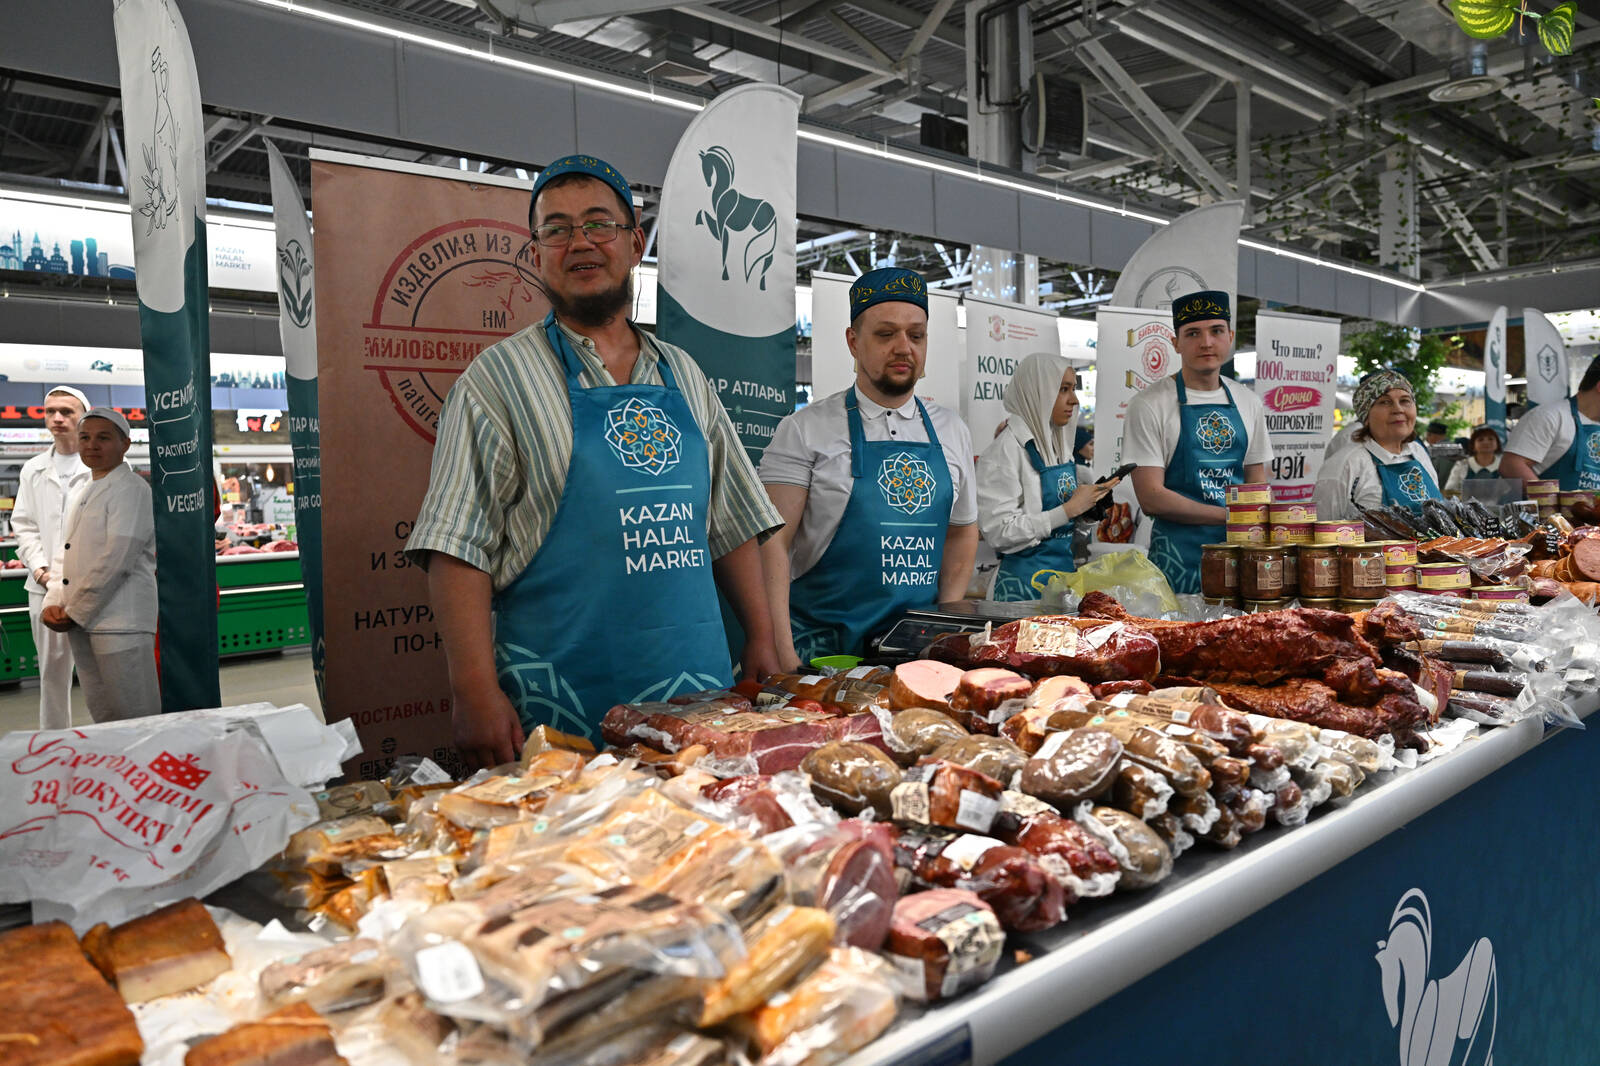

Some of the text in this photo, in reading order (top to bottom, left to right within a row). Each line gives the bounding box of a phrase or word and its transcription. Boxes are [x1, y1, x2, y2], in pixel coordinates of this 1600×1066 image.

[482, 310, 507, 329] НМ
[1271, 340, 1291, 357] Что
[1255, 360, 1284, 380] 1000
[732, 380, 786, 404] АТЛАРЫ
[1274, 387, 1313, 412] Срочно
[1199, 468, 1234, 478] KAZAN
[1271, 451, 1306, 480] ЧЭЙ
[619, 502, 693, 526] KAZAN
[622, 526, 694, 550] HALAL
[880, 535, 935, 551] KAZAN
[371, 552, 386, 570] И
[625, 549, 705, 574] MARKET
[881, 554, 933, 569] HALAL
[882, 570, 938, 586] MARKET
[26, 776, 214, 854] за окупку!
